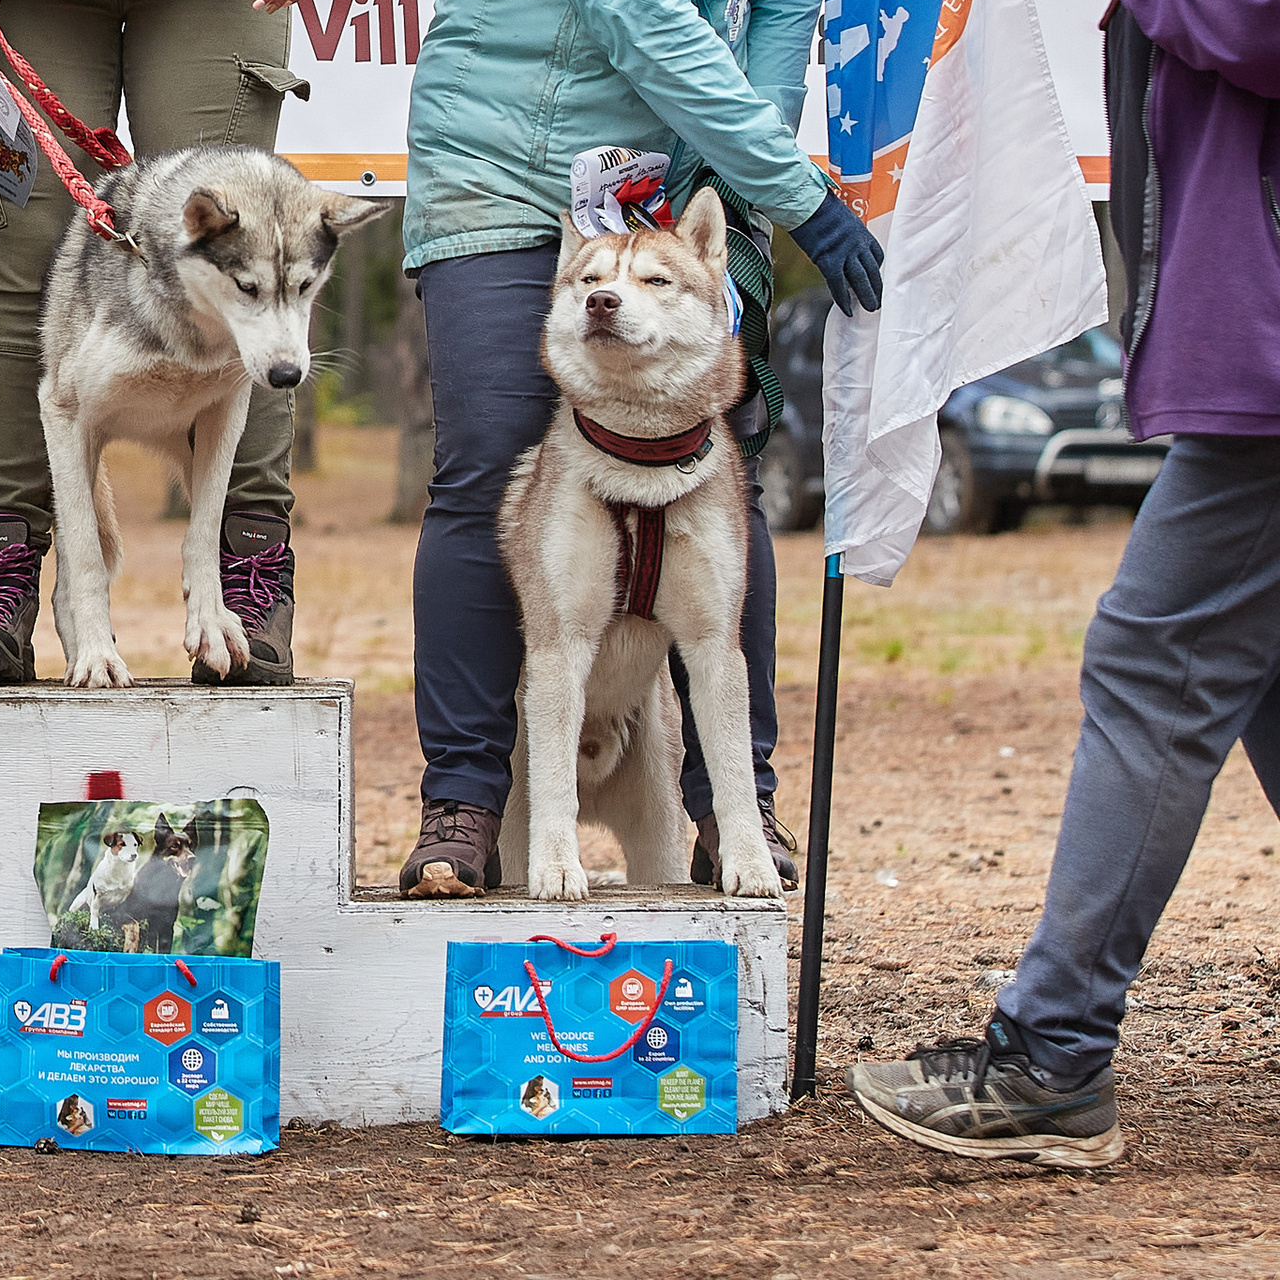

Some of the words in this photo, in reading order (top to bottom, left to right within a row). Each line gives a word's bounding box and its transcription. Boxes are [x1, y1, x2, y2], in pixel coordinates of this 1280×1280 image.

[23, 1002, 87, 1032] АВЗ
[530, 1032, 546, 1040] WE
[551, 1032, 595, 1040] RODUCE
[57, 1049, 72, 1059] МЫ
[74, 1051, 140, 1063] ПРОИЗВОДИМ
[524, 1055, 545, 1063] AND
[547, 1055, 561, 1063] DO
[69, 1062, 126, 1074] ЛЕКАРСТВА
[38, 1071, 45, 1080] И
[47, 1072, 86, 1083] ДЕЛАЕМ
[89, 1075, 108, 1084] ЭТО
[110, 1076, 160, 1085] ХОРОШО!
